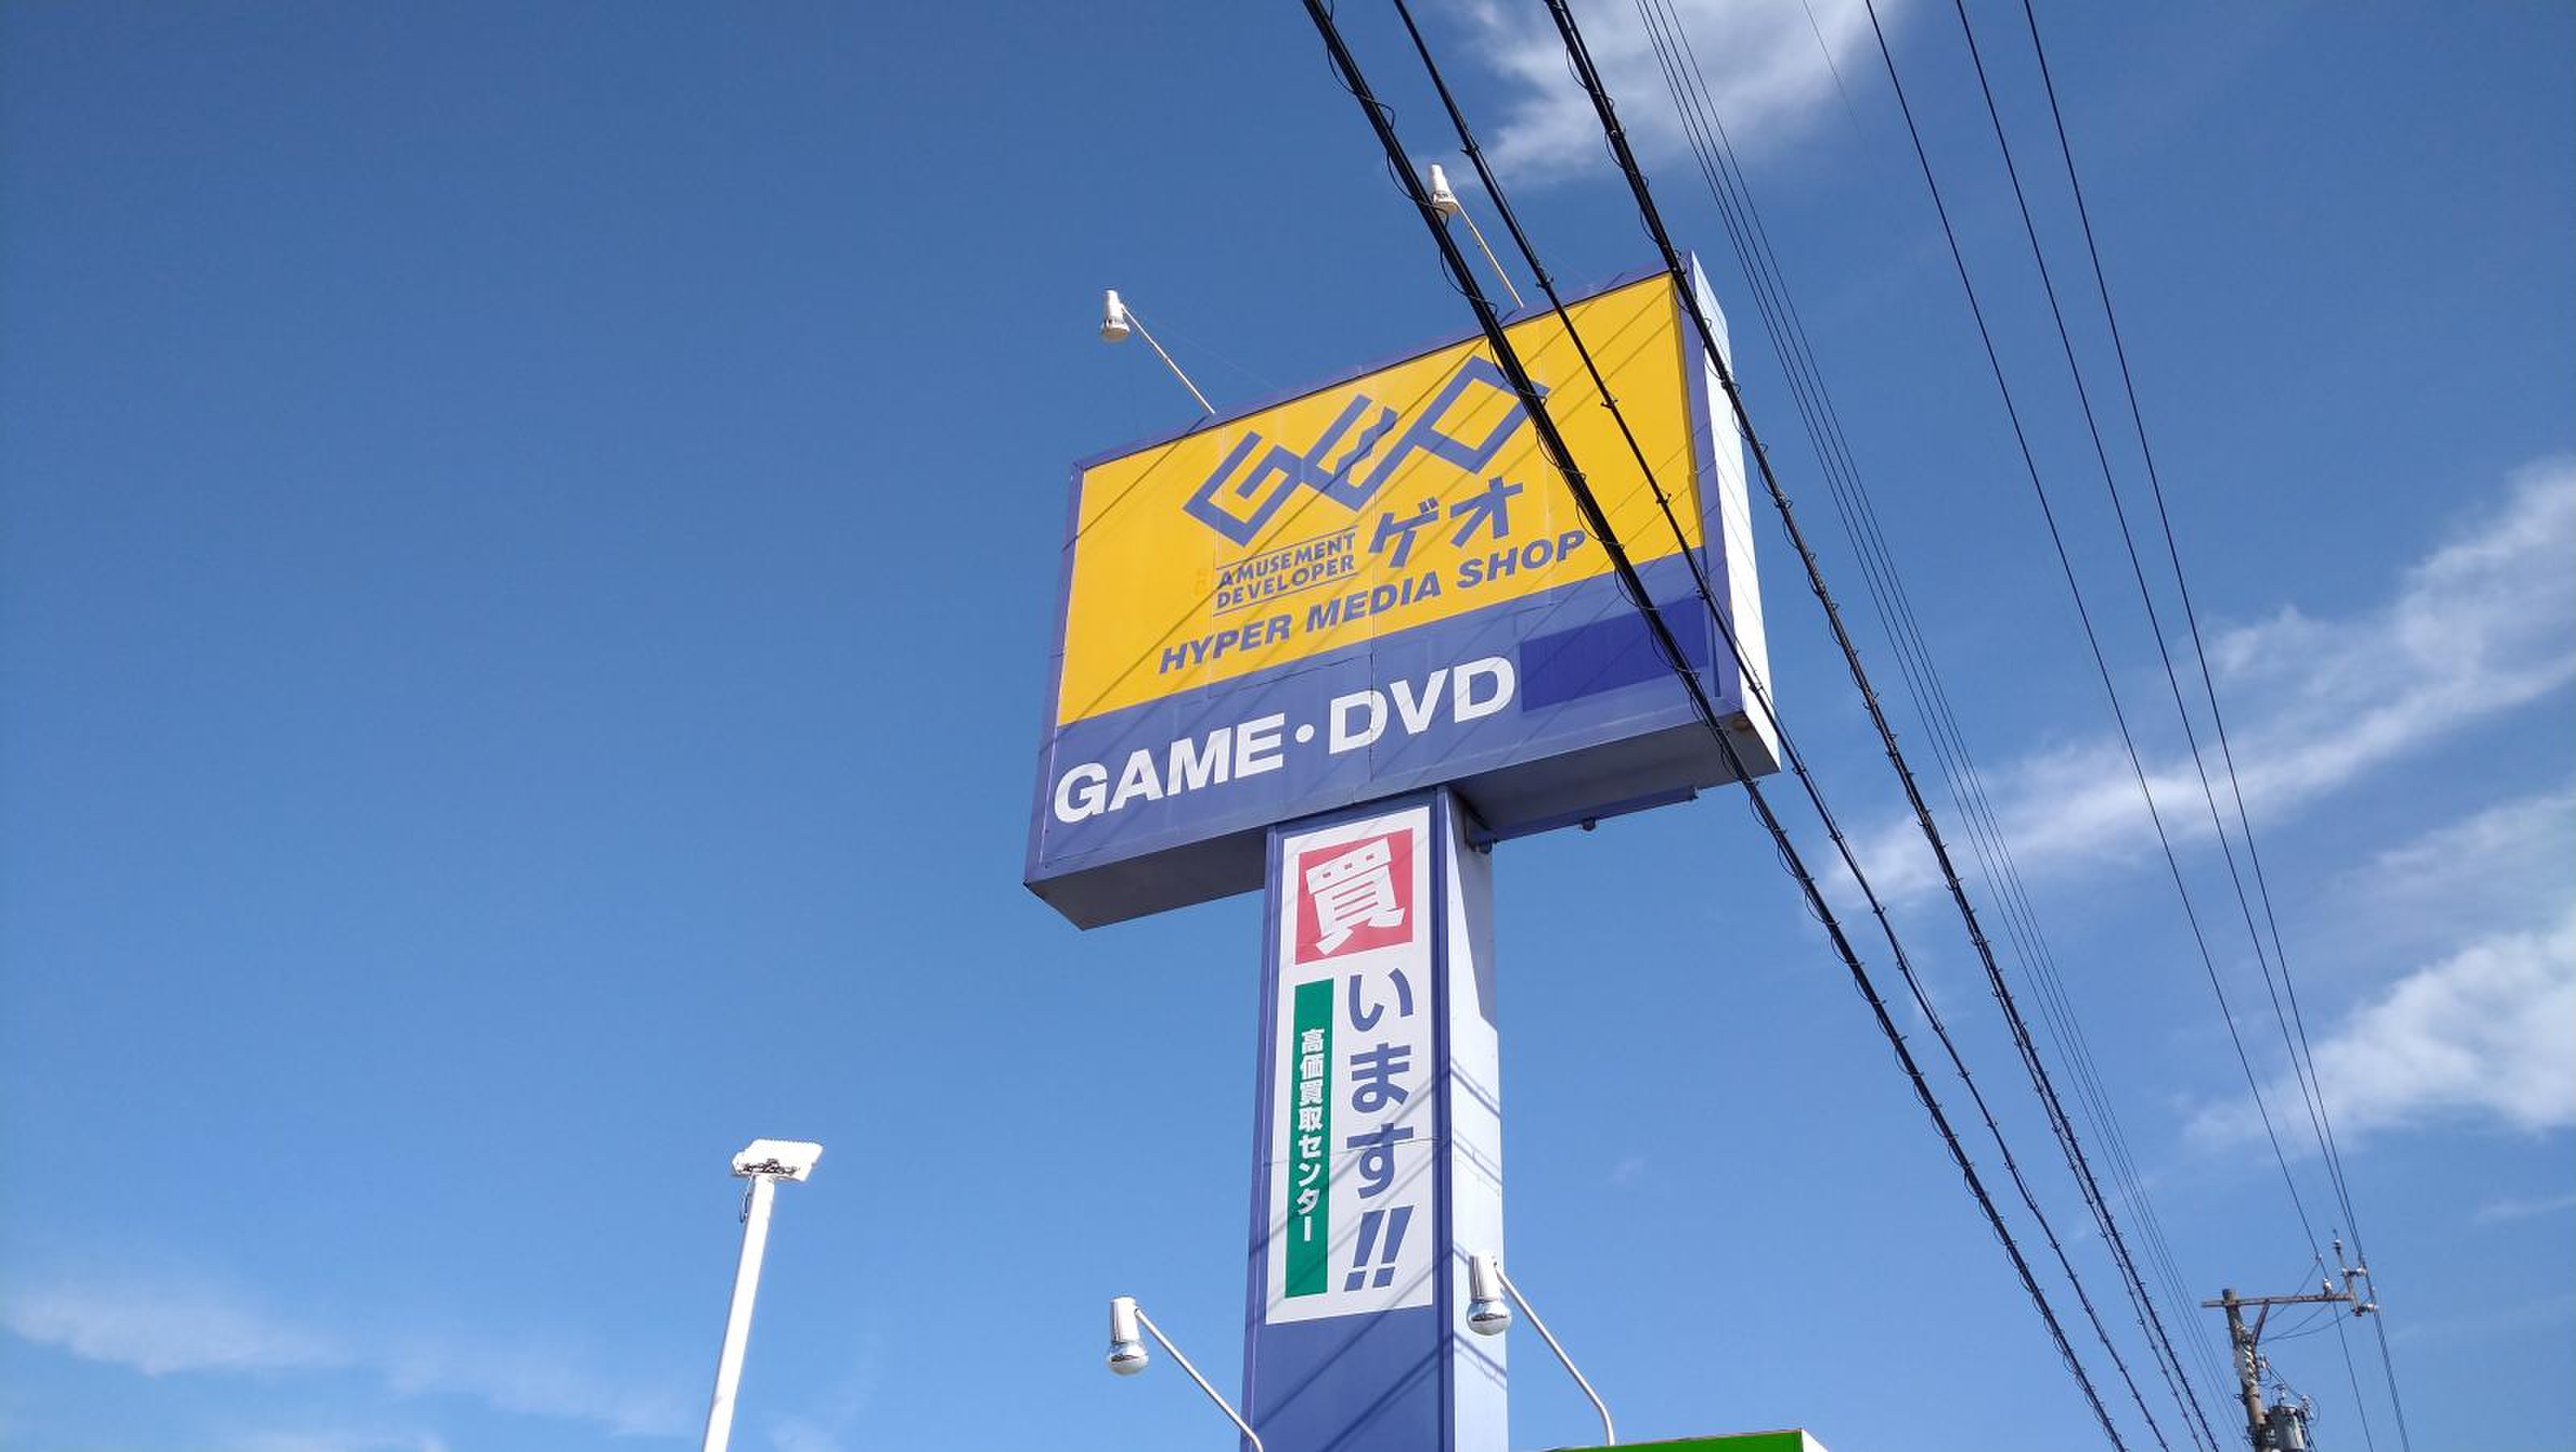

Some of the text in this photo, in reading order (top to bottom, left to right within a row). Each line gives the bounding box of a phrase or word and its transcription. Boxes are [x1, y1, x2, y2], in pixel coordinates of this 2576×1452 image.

[1216, 532, 1355, 589] AMUSEMENT
[1369, 477, 1523, 570] ゲオ
[1159, 529, 1587, 674] HYPER MEDIA SHOP
[1216, 555, 1355, 609] DEVELOPER
[1296, 1028, 1325, 1242] 高価買取センター
